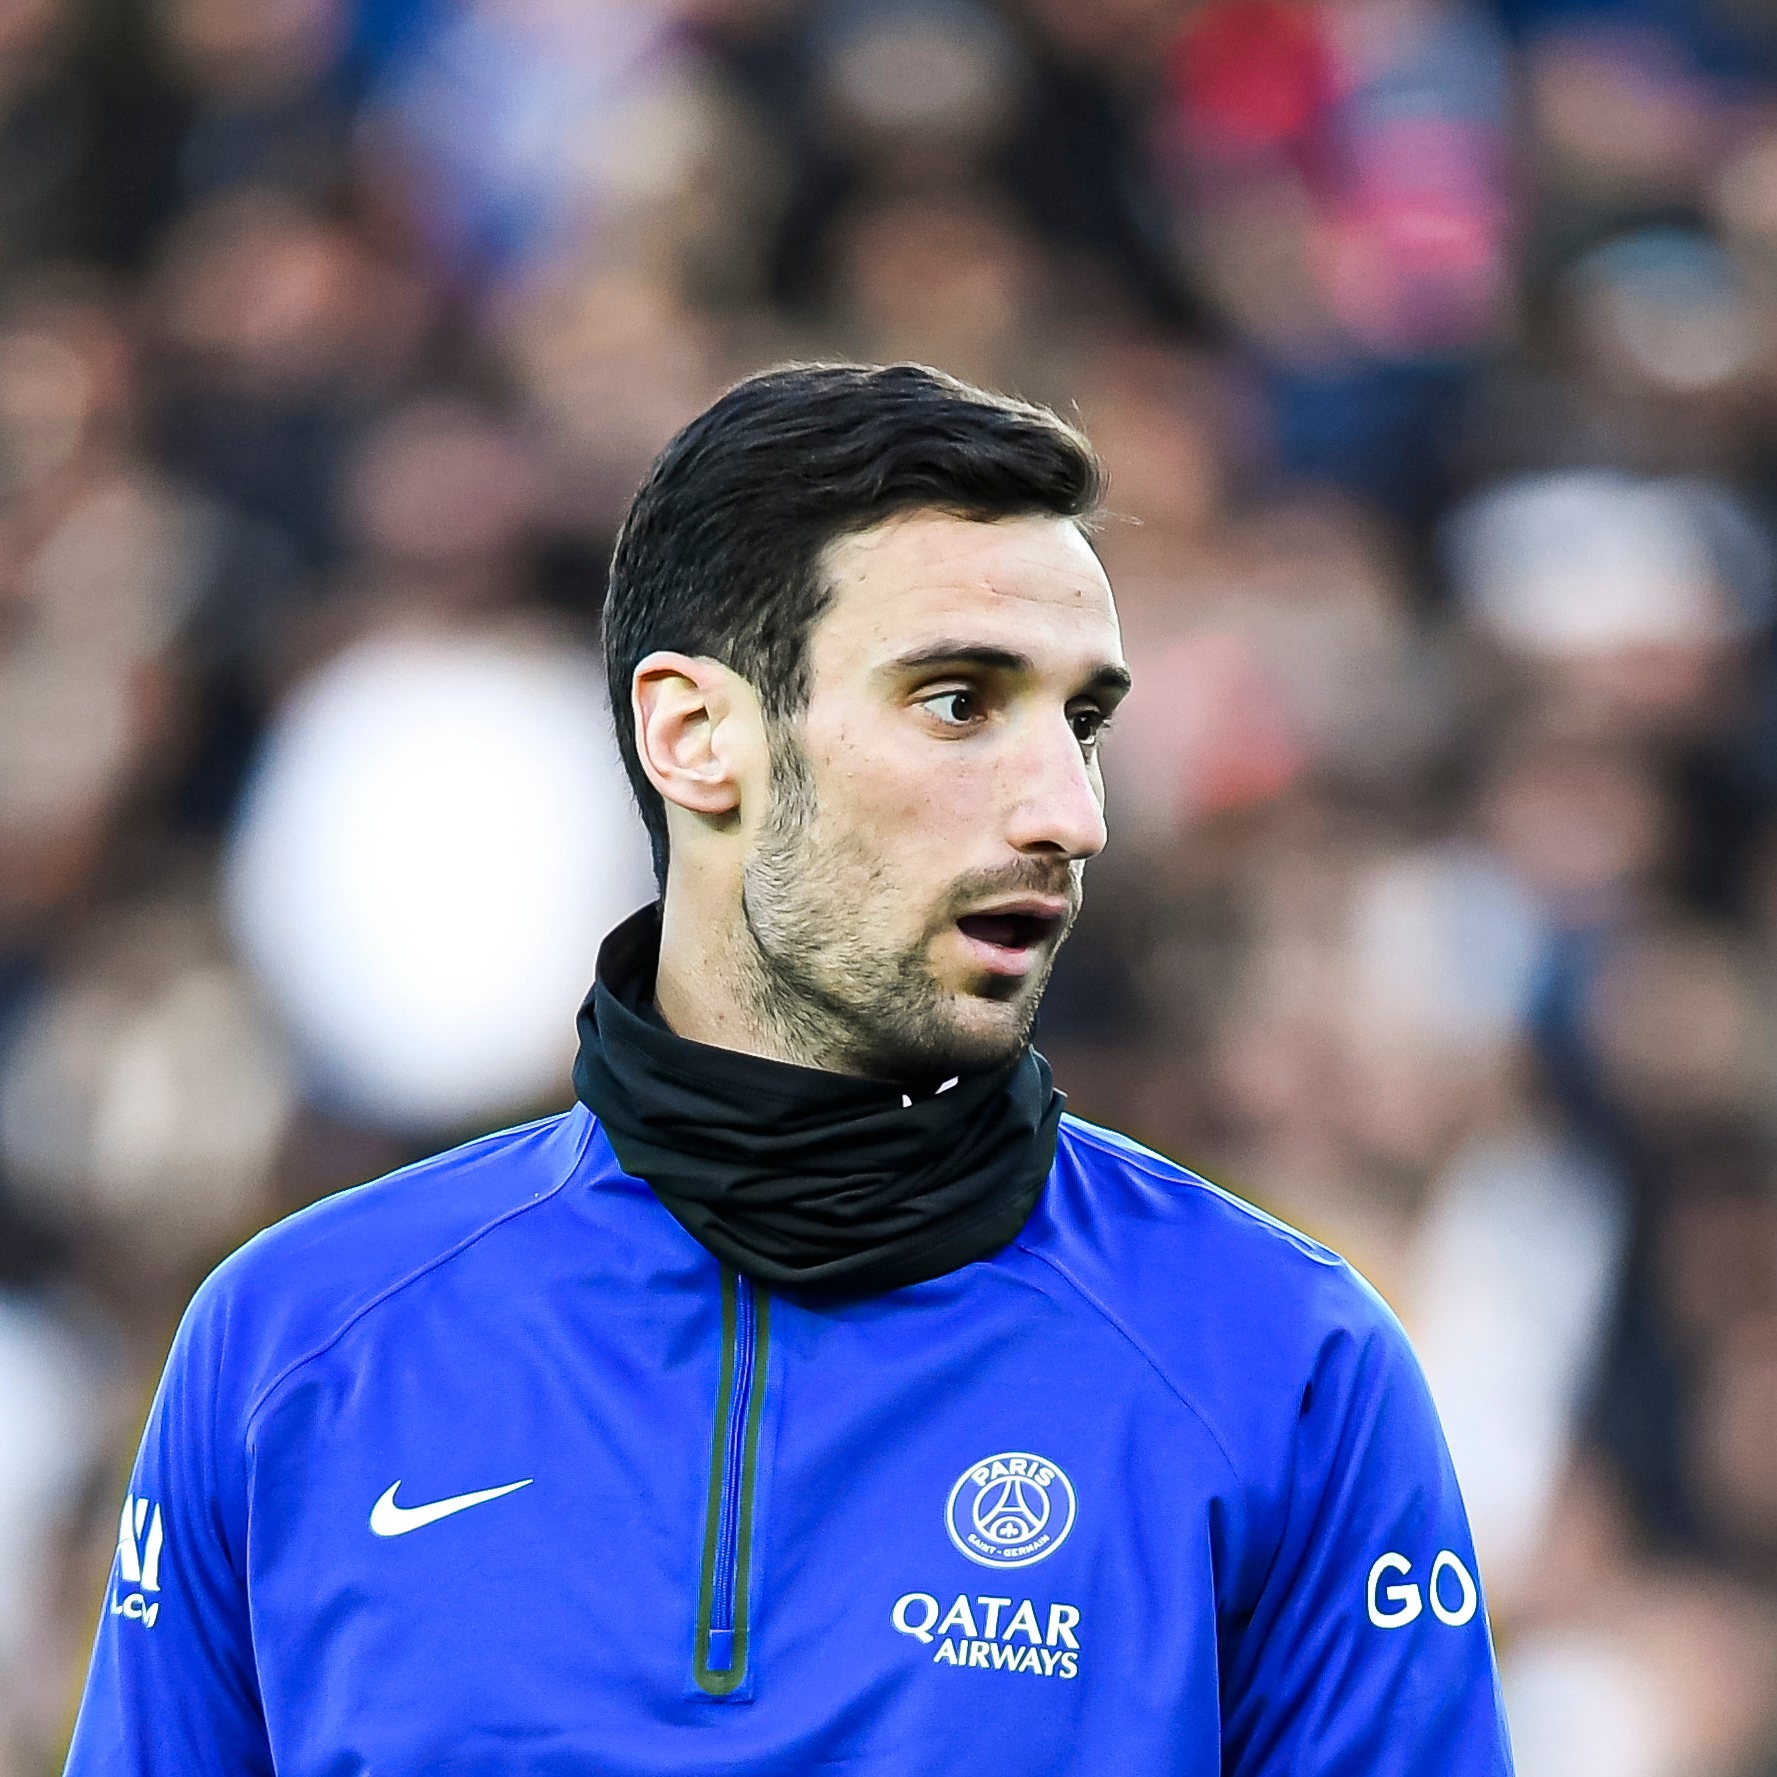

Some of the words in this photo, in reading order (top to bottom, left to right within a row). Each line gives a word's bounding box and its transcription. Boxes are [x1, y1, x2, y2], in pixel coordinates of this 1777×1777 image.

[971, 1459, 1056, 1487] PARIS
[1367, 1550, 1477, 1629] GO
[890, 1592, 1080, 1649] QATAR
[933, 1638, 1079, 1679] AIRWAYS
